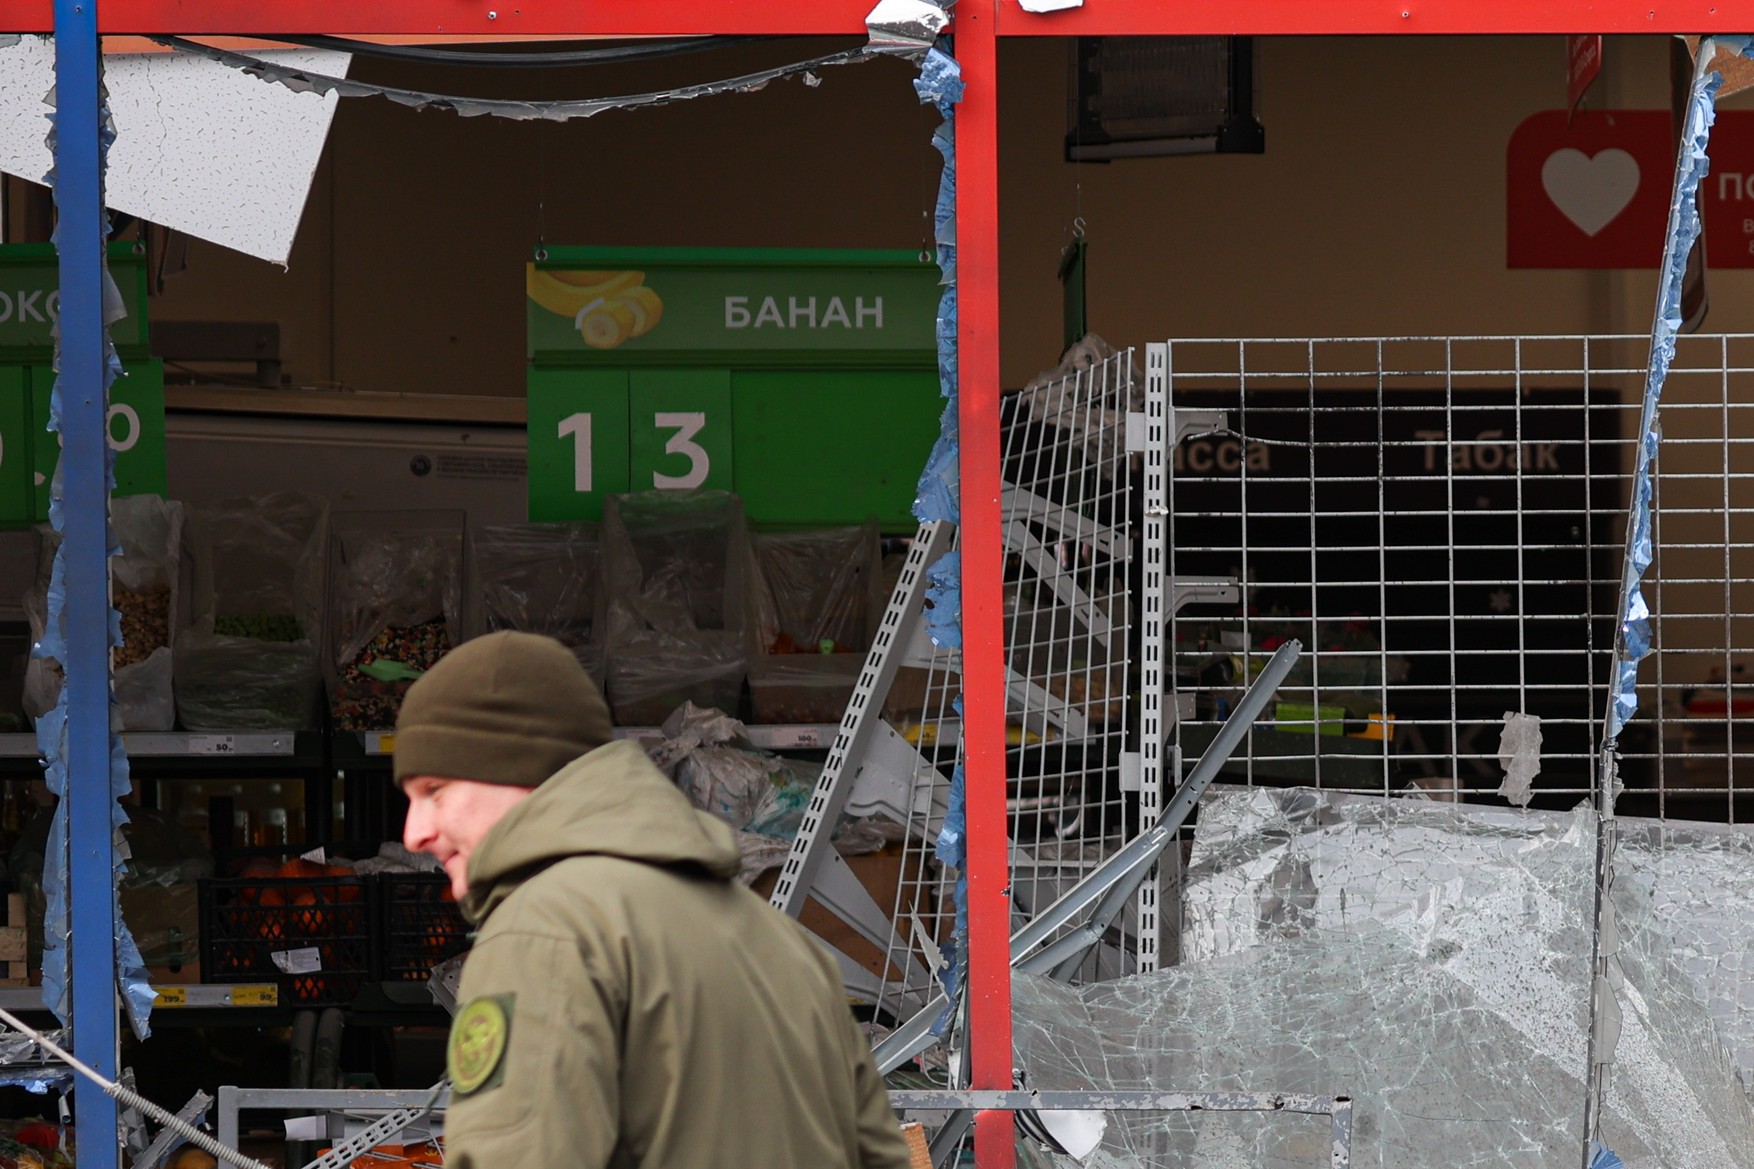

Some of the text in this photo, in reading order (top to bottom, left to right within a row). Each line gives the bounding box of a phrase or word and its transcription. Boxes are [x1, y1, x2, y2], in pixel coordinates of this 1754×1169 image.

[723, 295, 884, 329] БАНАН
[1414, 429, 1560, 471] Табак
[215, 743, 228, 751] 50
